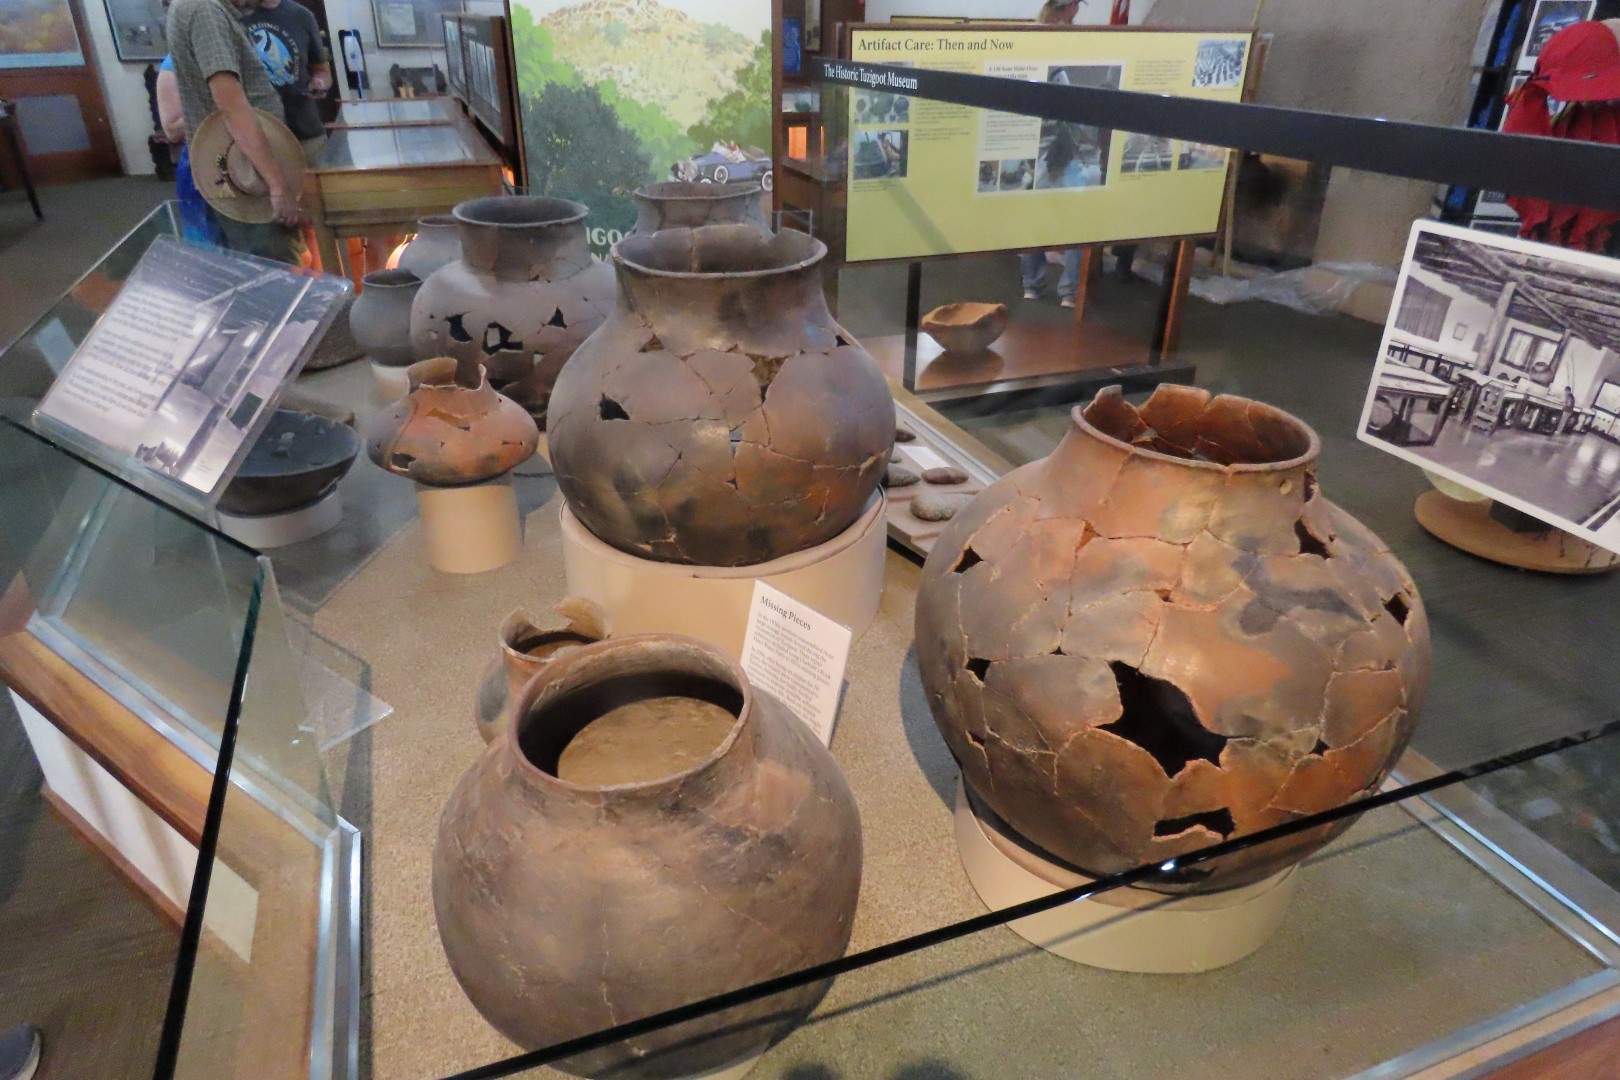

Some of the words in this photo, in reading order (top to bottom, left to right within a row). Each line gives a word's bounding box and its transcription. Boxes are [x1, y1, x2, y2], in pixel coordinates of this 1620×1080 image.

[858, 38, 901, 50] Artifact
[905, 39, 934, 50] Care:
[937, 38, 965, 50] Then
[967, 38, 987, 50] and
[989, 39, 1014, 50] Now
[824, 63, 835, 78] The
[835, 65, 858, 82] Historic
[859, 68, 887, 88] Tuzigoot
[887, 71, 918, 90] Museum
[760, 595, 788, 620] Missing
[788, 611, 811, 631] Pieces
